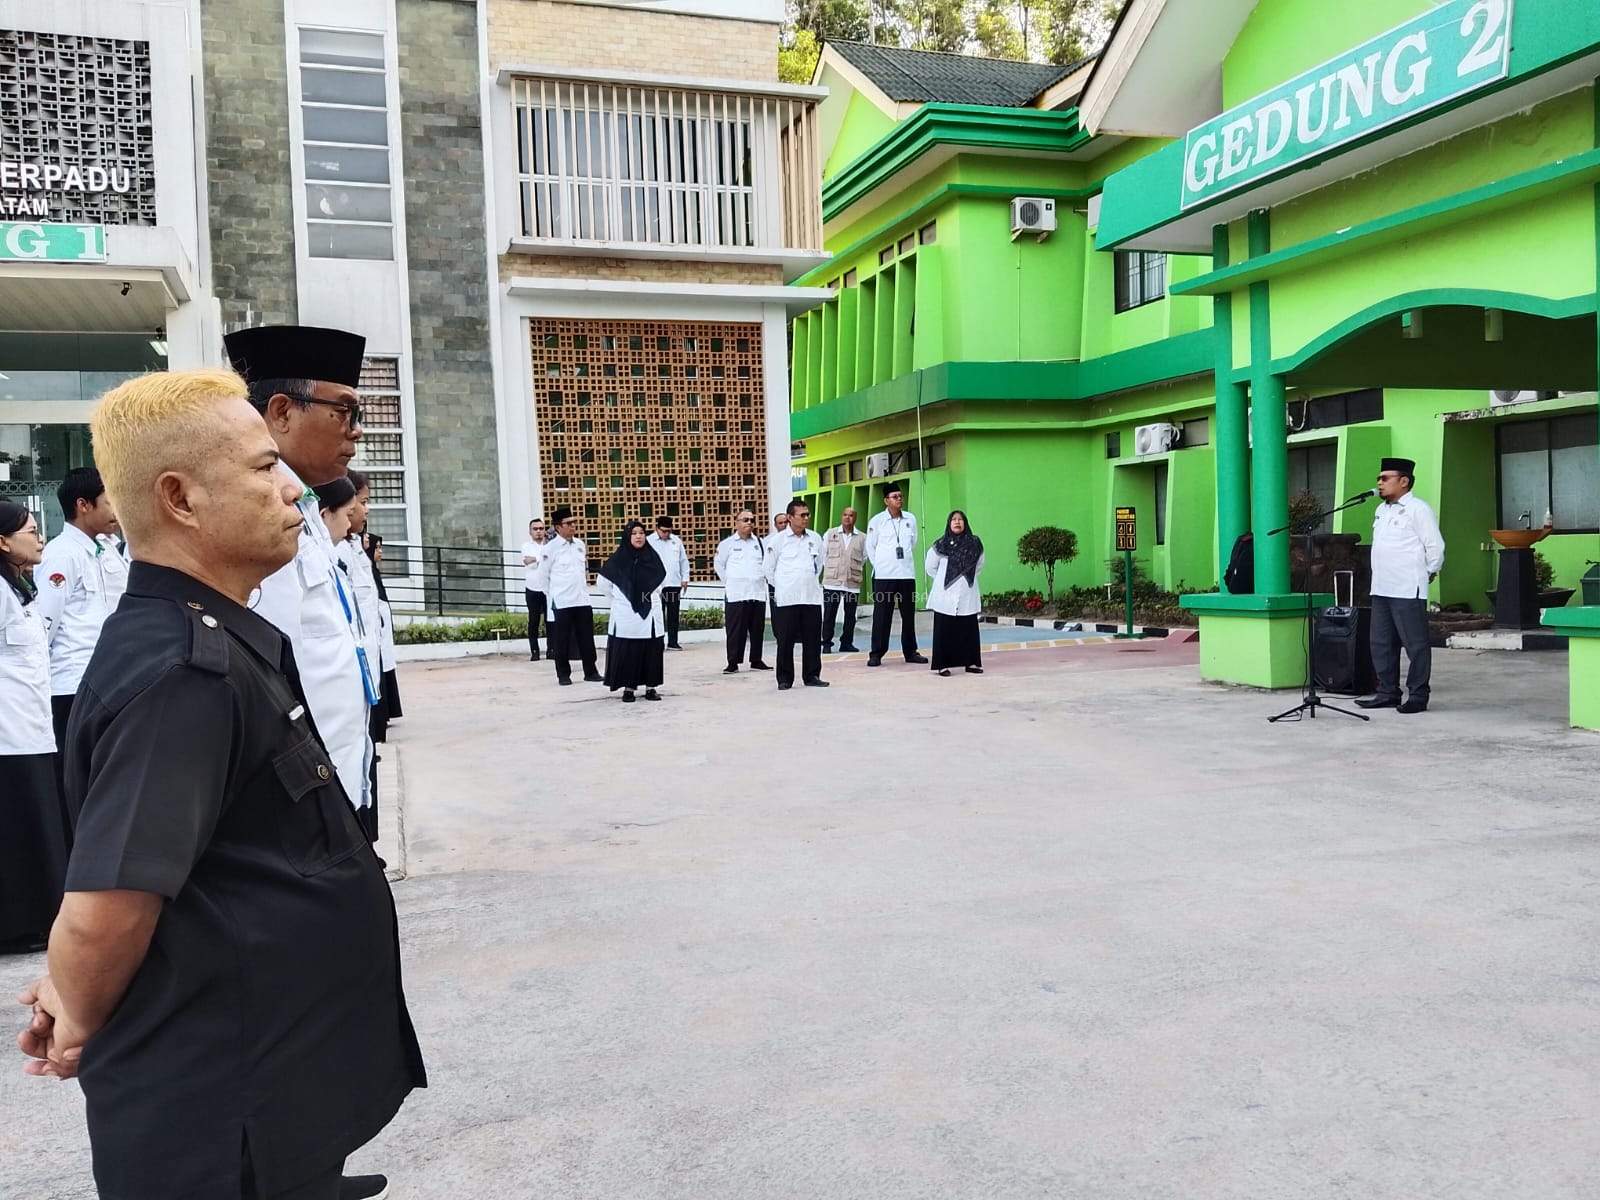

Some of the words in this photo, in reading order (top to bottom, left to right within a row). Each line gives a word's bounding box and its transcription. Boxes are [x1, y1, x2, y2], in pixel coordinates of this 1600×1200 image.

[1186, 30, 1432, 192] GEDUNG
[1457, 0, 1504, 77] 2
[0, 161, 130, 193] ERPADU
[0, 224, 51, 259] G
[76, 226, 104, 259] 1
